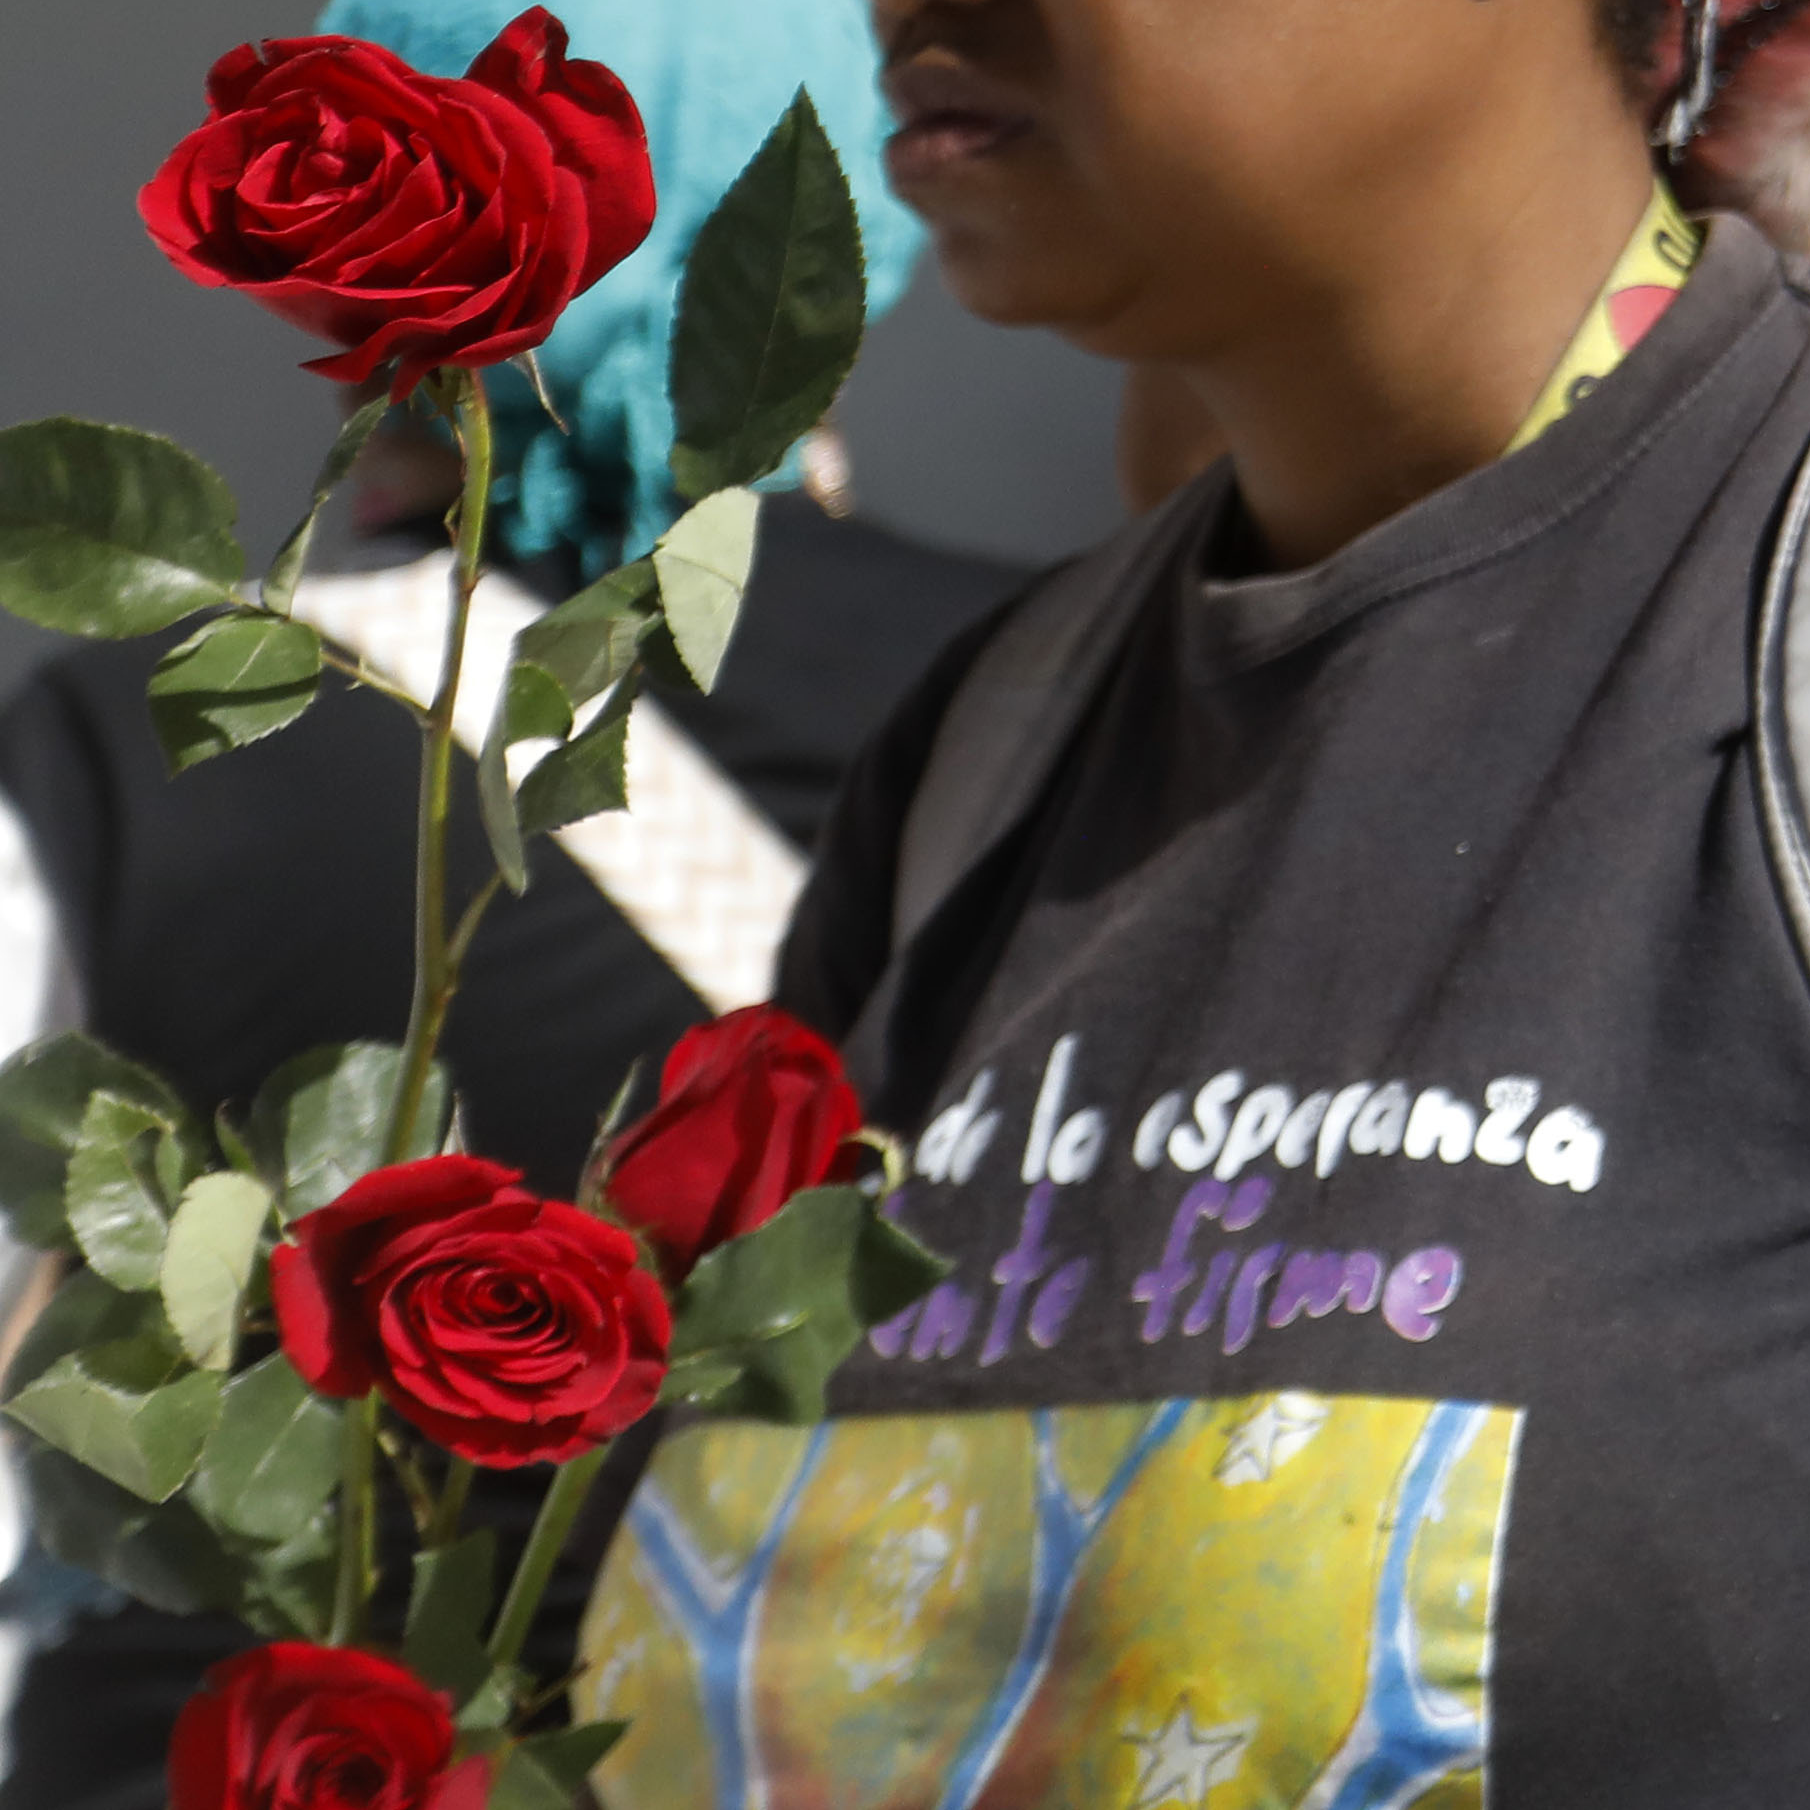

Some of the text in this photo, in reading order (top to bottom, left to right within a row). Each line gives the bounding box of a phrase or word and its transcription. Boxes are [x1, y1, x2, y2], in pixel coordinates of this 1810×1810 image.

[1020, 1031, 1109, 1185] la
[1132, 1068, 1606, 1193] esperanza
[1130, 1176, 1464, 1357] firme
